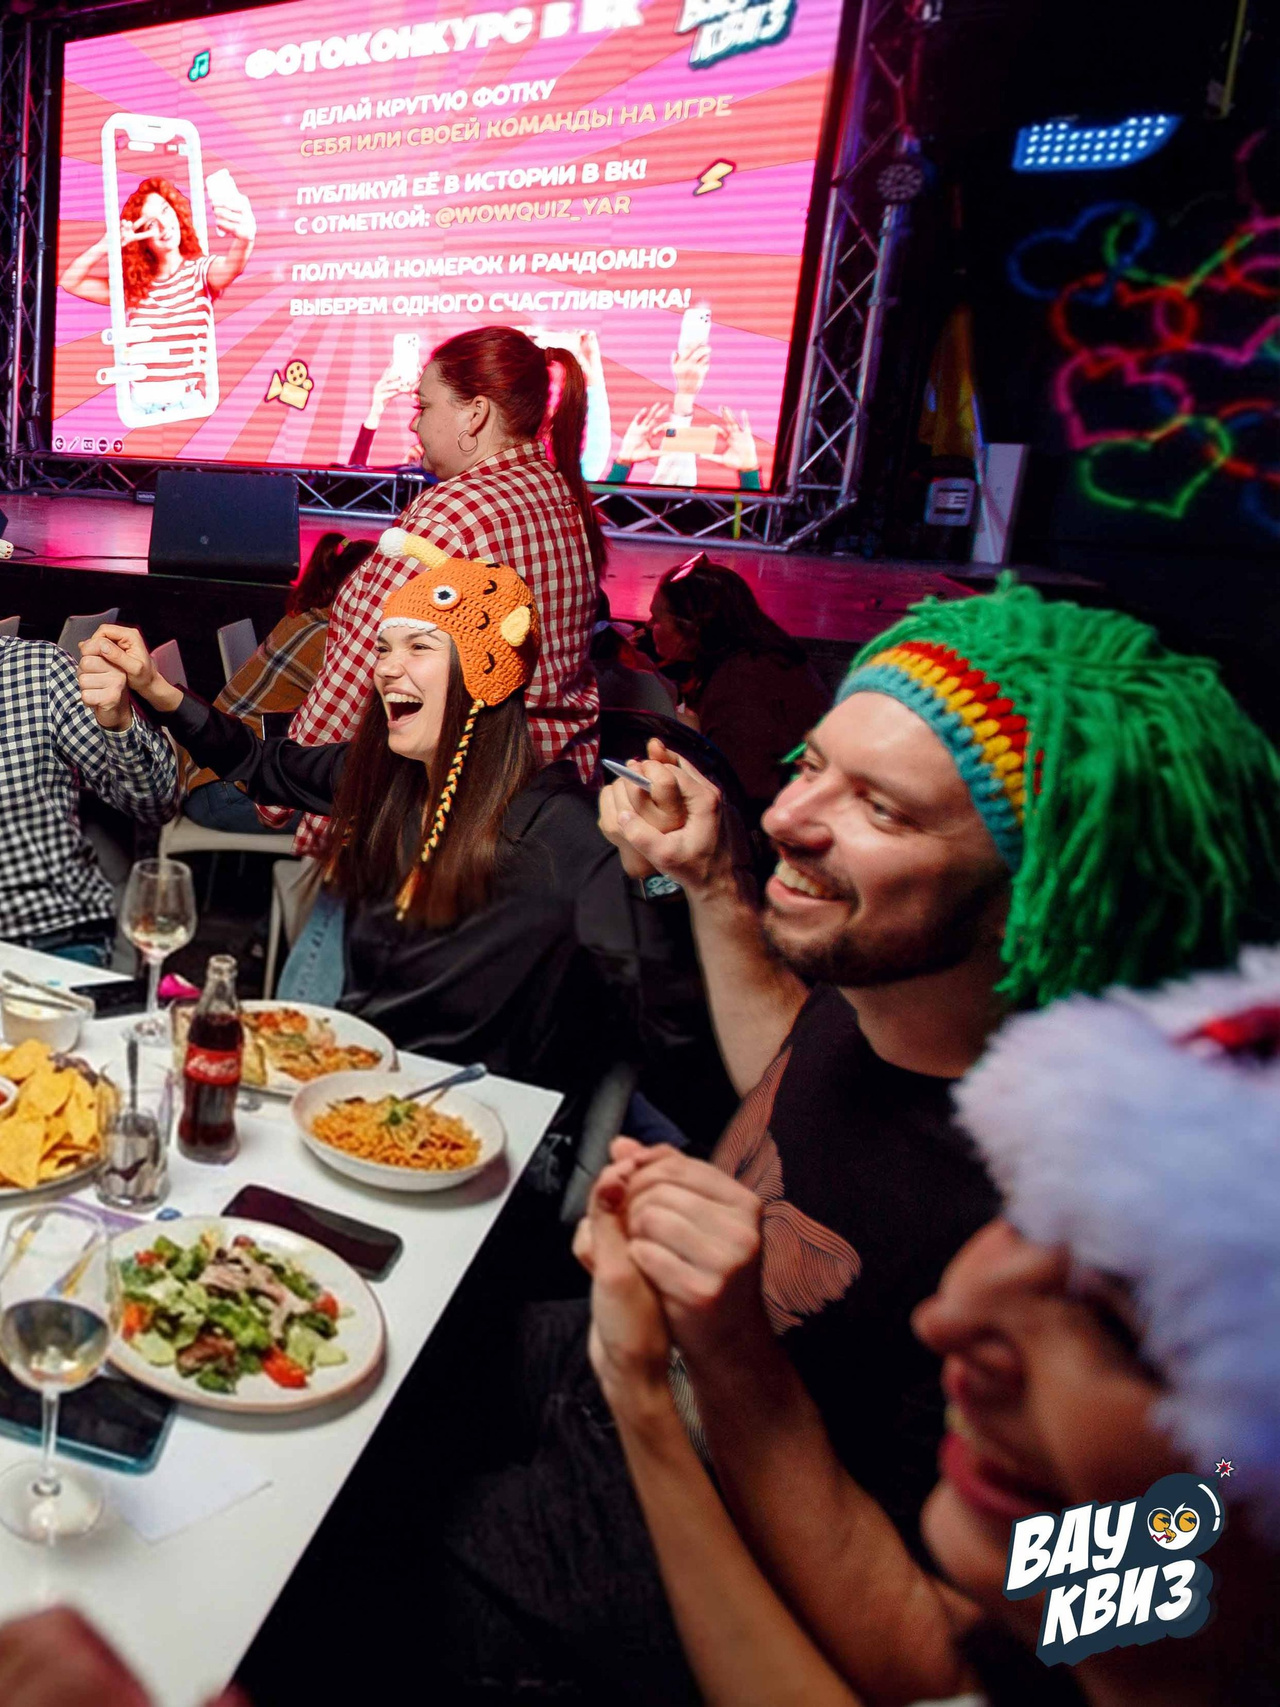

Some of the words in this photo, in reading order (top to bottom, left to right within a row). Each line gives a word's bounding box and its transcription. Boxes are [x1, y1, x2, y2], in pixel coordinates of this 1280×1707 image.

[245, 8, 534, 80] ФОТОКОНКУРС
[539, 1, 575, 39] В
[299, 97, 372, 131] ДЕЛАЙ
[376, 90, 468, 119] КРУТУЮ
[472, 79, 557, 108] ФОТКУ
[300, 135, 352, 158] СЕБЯ
[357, 130, 402, 152] ИЛИ
[406, 116, 481, 147] СВОЕЙ
[486, 107, 614, 139] КОМАНДЫ
[620, 103, 657, 125] НА
[663, 95, 734, 122] ИГРЕ
[296, 174, 408, 205] ПУБЛИКУЙ
[412, 171, 440, 197] ЕЁ
[443, 174, 460, 195] В
[464, 165, 577, 192] ИСТОРИИ
[581, 163, 600, 184] В
[604, 158, 647, 182] ВК!
[294, 217, 309, 235] С
[311, 204, 431, 234] ОТМЕТКОЙ:
[434, 196, 631, 229] @WOWQUIZ_YAR
[291, 255, 390, 282] ПОЛУЧАЙ
[393, 255, 503, 279] НОМЕРОК
[509, 254, 526, 274] И
[531, 247, 677, 275] РАНДОМНО
[289, 296, 387, 316] ВЫБЕРЕМ
[392, 293, 484, 317] ОДНОГО
[489, 288, 691, 313] СЧАСТЛИВЧИКА!
